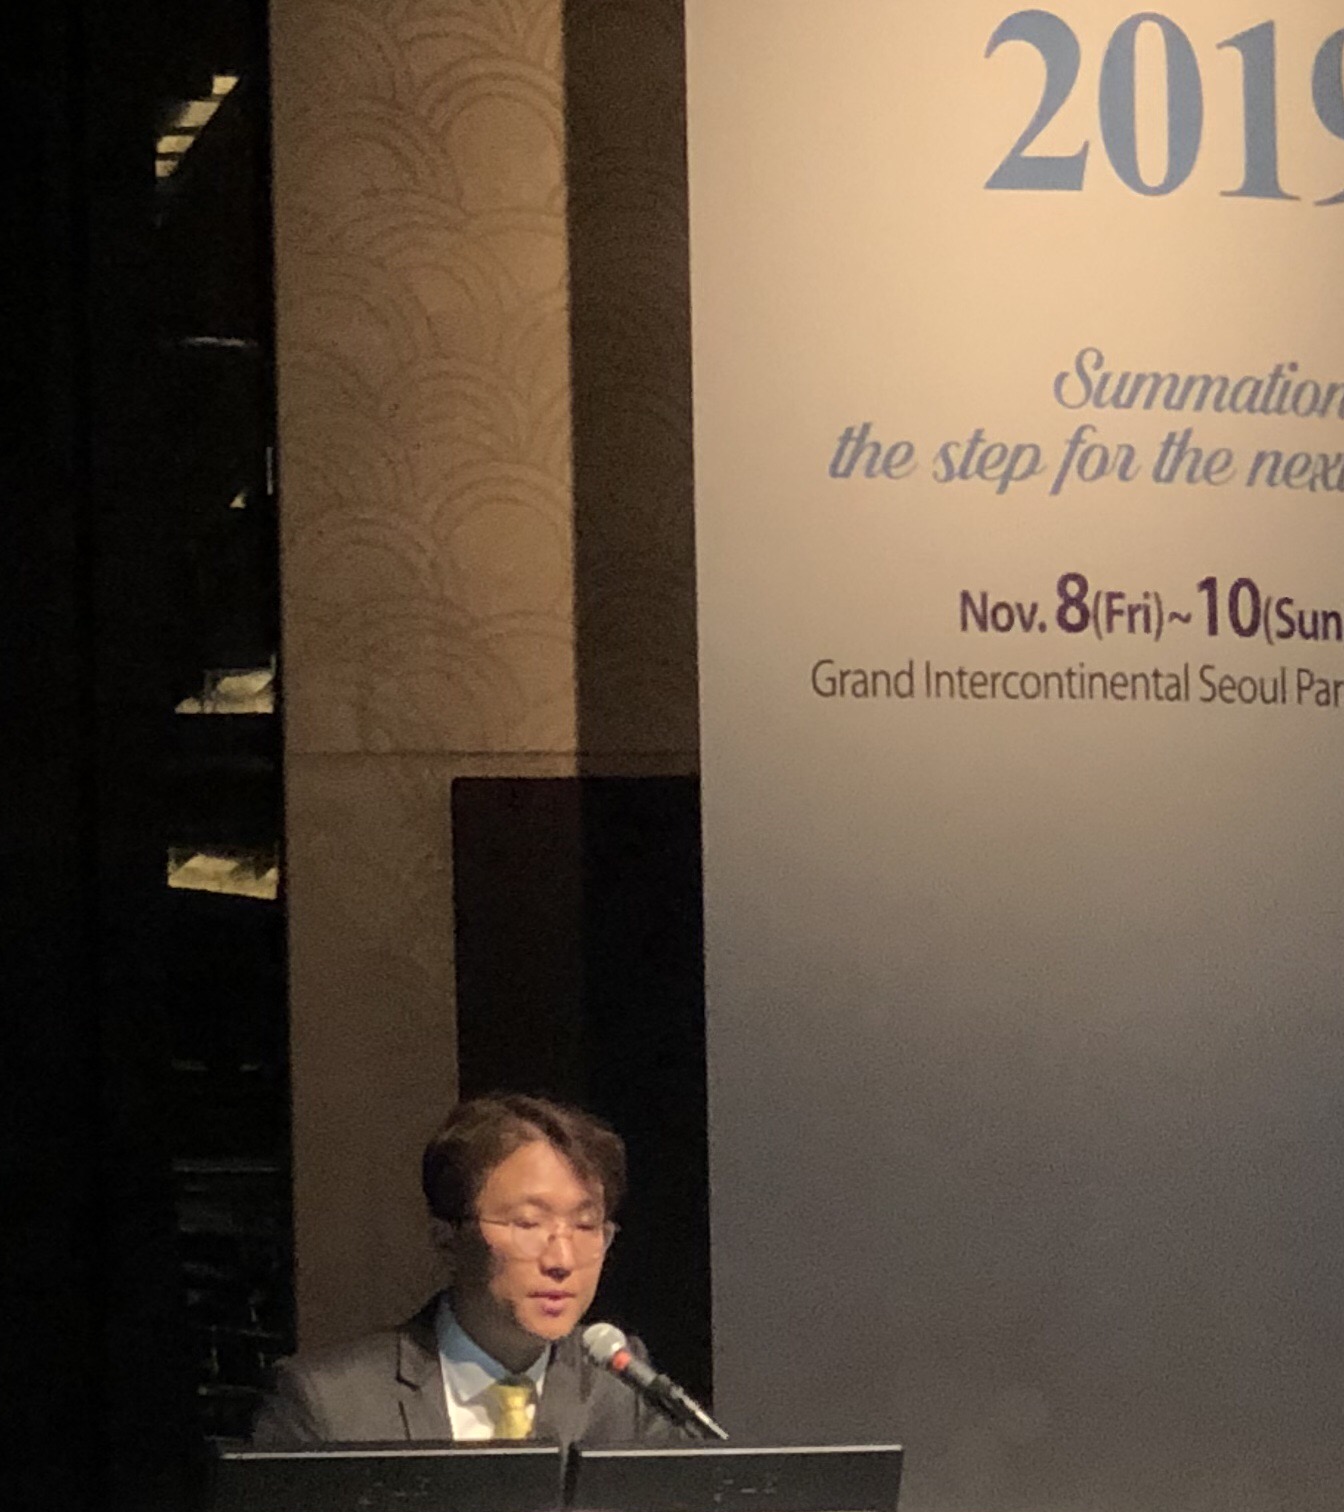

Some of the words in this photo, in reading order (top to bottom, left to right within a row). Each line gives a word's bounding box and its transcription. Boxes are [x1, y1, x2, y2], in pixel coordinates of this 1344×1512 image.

[828, 421, 918, 480] the
[932, 427, 1047, 495] step
[1049, 423, 1141, 496] for
[1151, 427, 1237, 487] the
[959, 588, 1048, 634] Nov.
[811, 658, 915, 699] Grand
[925, 660, 1191, 702] Intercontinental
[1198, 664, 1287, 705] Seoul
